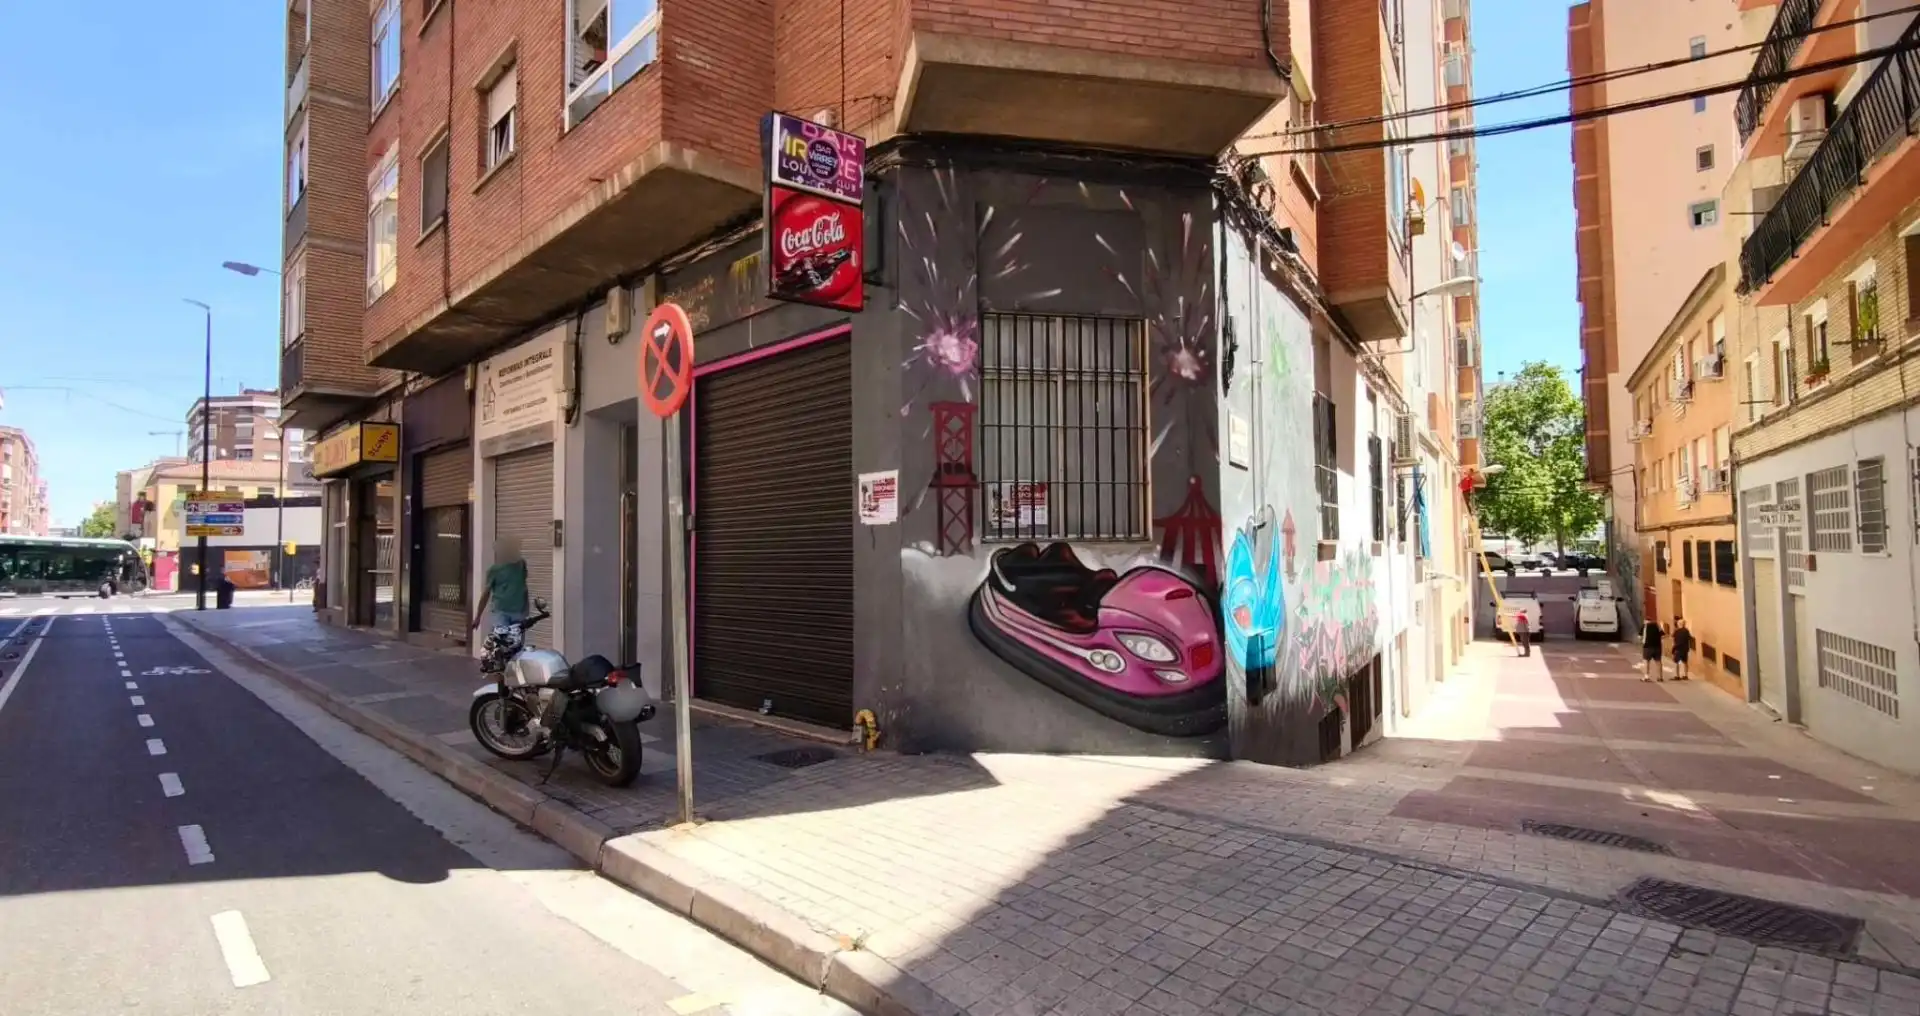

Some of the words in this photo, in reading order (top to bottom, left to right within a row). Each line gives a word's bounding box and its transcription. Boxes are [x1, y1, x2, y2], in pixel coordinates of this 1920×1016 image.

[802, 121, 857, 156] BAR
[815, 144, 832, 156] BAR
[809, 151, 838, 167] VIRREY
